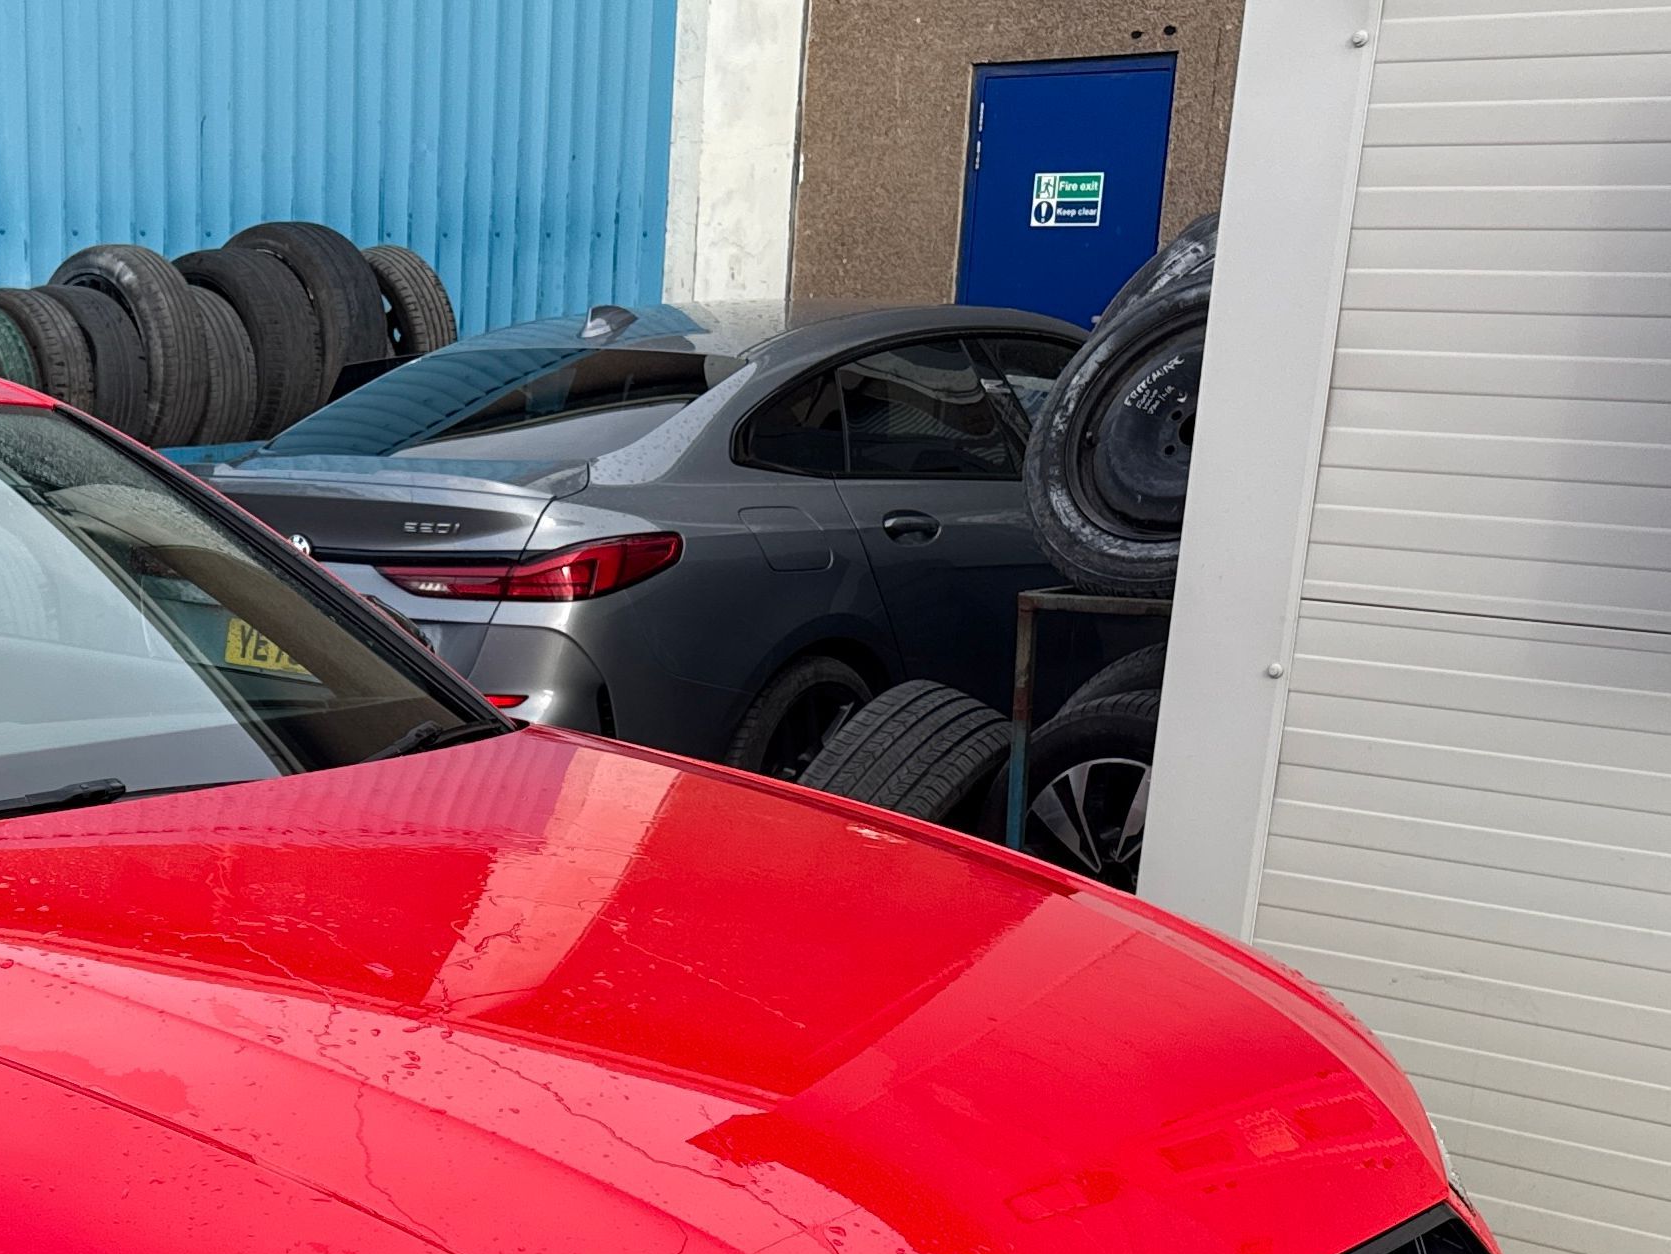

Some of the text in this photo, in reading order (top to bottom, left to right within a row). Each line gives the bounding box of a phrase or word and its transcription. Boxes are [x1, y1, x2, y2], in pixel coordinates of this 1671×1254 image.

[1059, 181, 1098, 191] Fire exit
[1057, 207, 1097, 217] Keep clear
